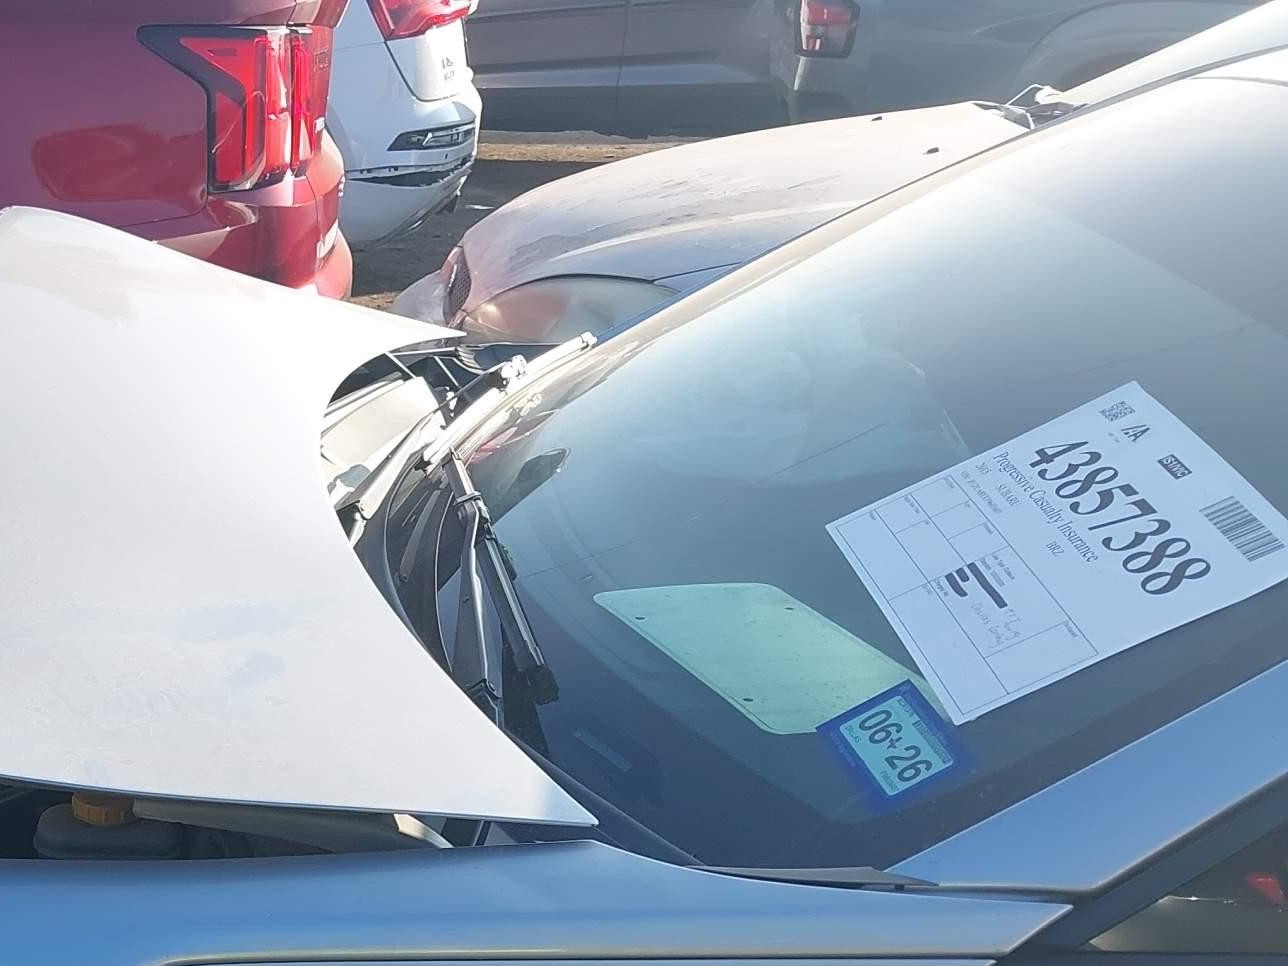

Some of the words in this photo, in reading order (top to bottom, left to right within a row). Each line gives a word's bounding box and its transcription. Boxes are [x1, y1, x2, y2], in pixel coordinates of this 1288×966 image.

[993, 450, 1035, 493] Progressive
[1029, 489, 1065, 525] Casualty
[1057, 520, 1098, 562] Insurance
[1029, 441, 1211, 595] 43857388
[1046, 540, 1065, 556] BRZ
[885, 745, 933, 782] 26
